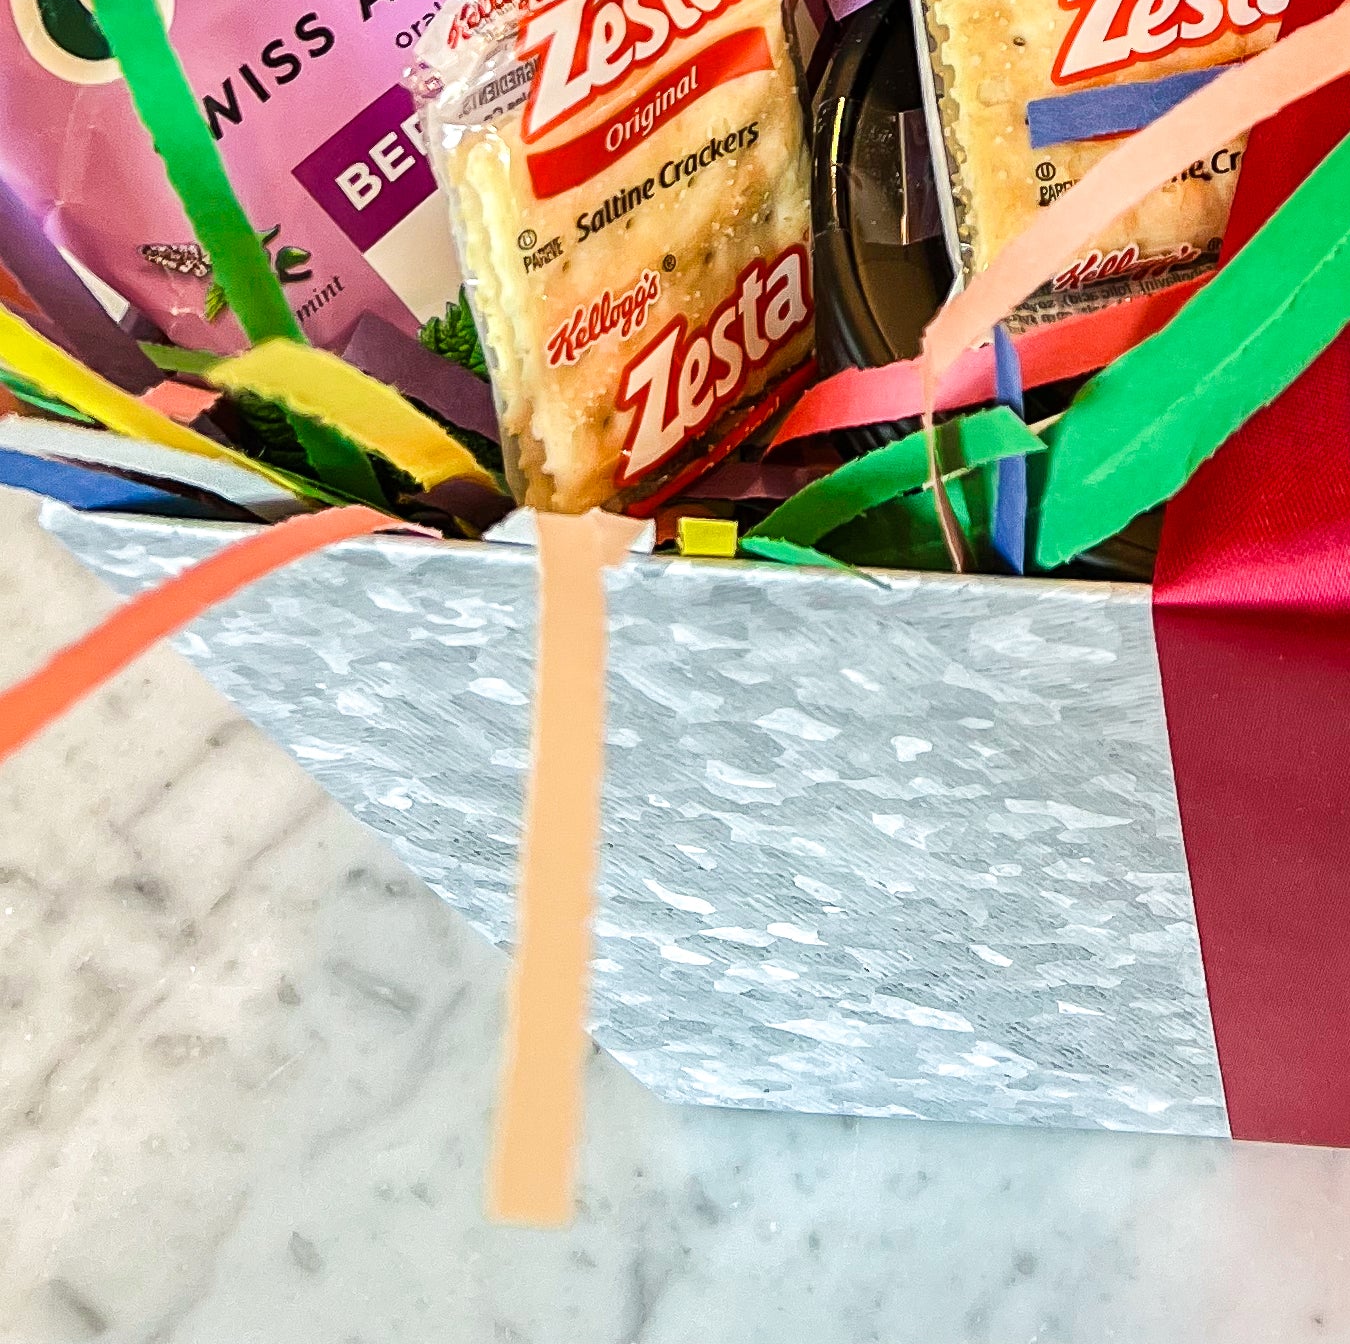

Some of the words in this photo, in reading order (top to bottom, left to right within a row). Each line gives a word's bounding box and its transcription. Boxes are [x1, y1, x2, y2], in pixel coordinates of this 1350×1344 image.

[202, 11, 336, 142] WISS
[606, 64, 699, 153] Original
[576, 181, 657, 243] Saltine
[658, 119, 760, 193] Crackers
[548, 271, 659, 366] Kellogg's
[624, 252, 804, 480] Zesta
